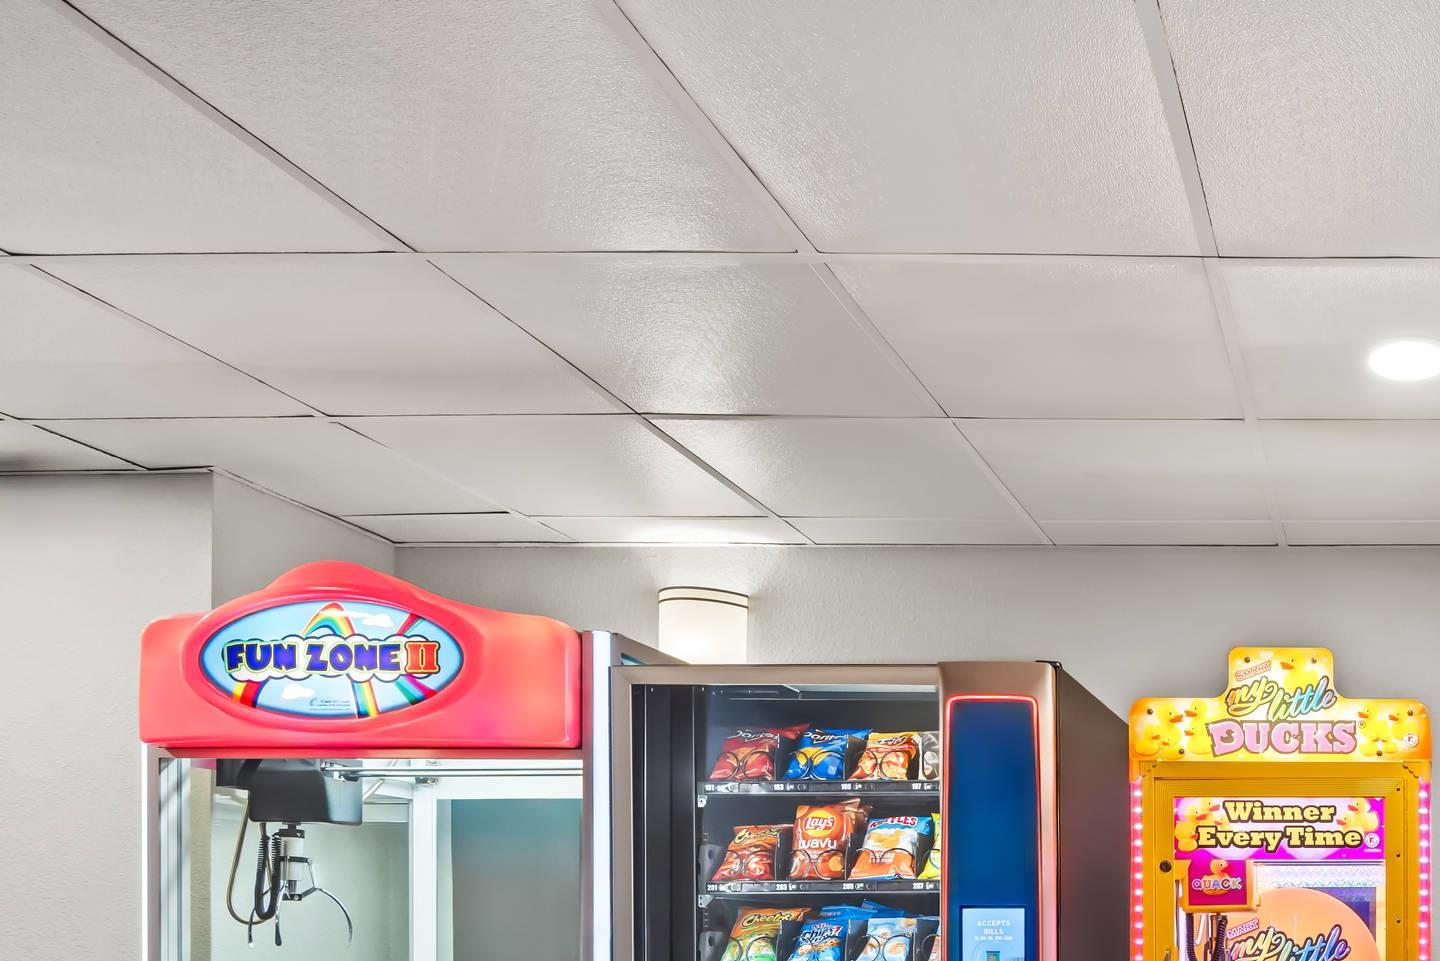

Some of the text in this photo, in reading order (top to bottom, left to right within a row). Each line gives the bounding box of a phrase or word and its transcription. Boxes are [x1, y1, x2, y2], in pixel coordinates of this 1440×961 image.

[225, 640, 440, 674] FUN ZONE II
[1234, 660, 1272, 681] SMART
[1225, 675, 1337, 721] my little
[1205, 719, 1357, 757] DUCKS
[1223, 801, 1336, 823] Winner
[1195, 825, 1365, 853] Every Time
[1192, 877, 1242, 891] QUACK
[976, 919, 1011, 927] ACCEPTS
[1227, 918, 1259, 938] MART
